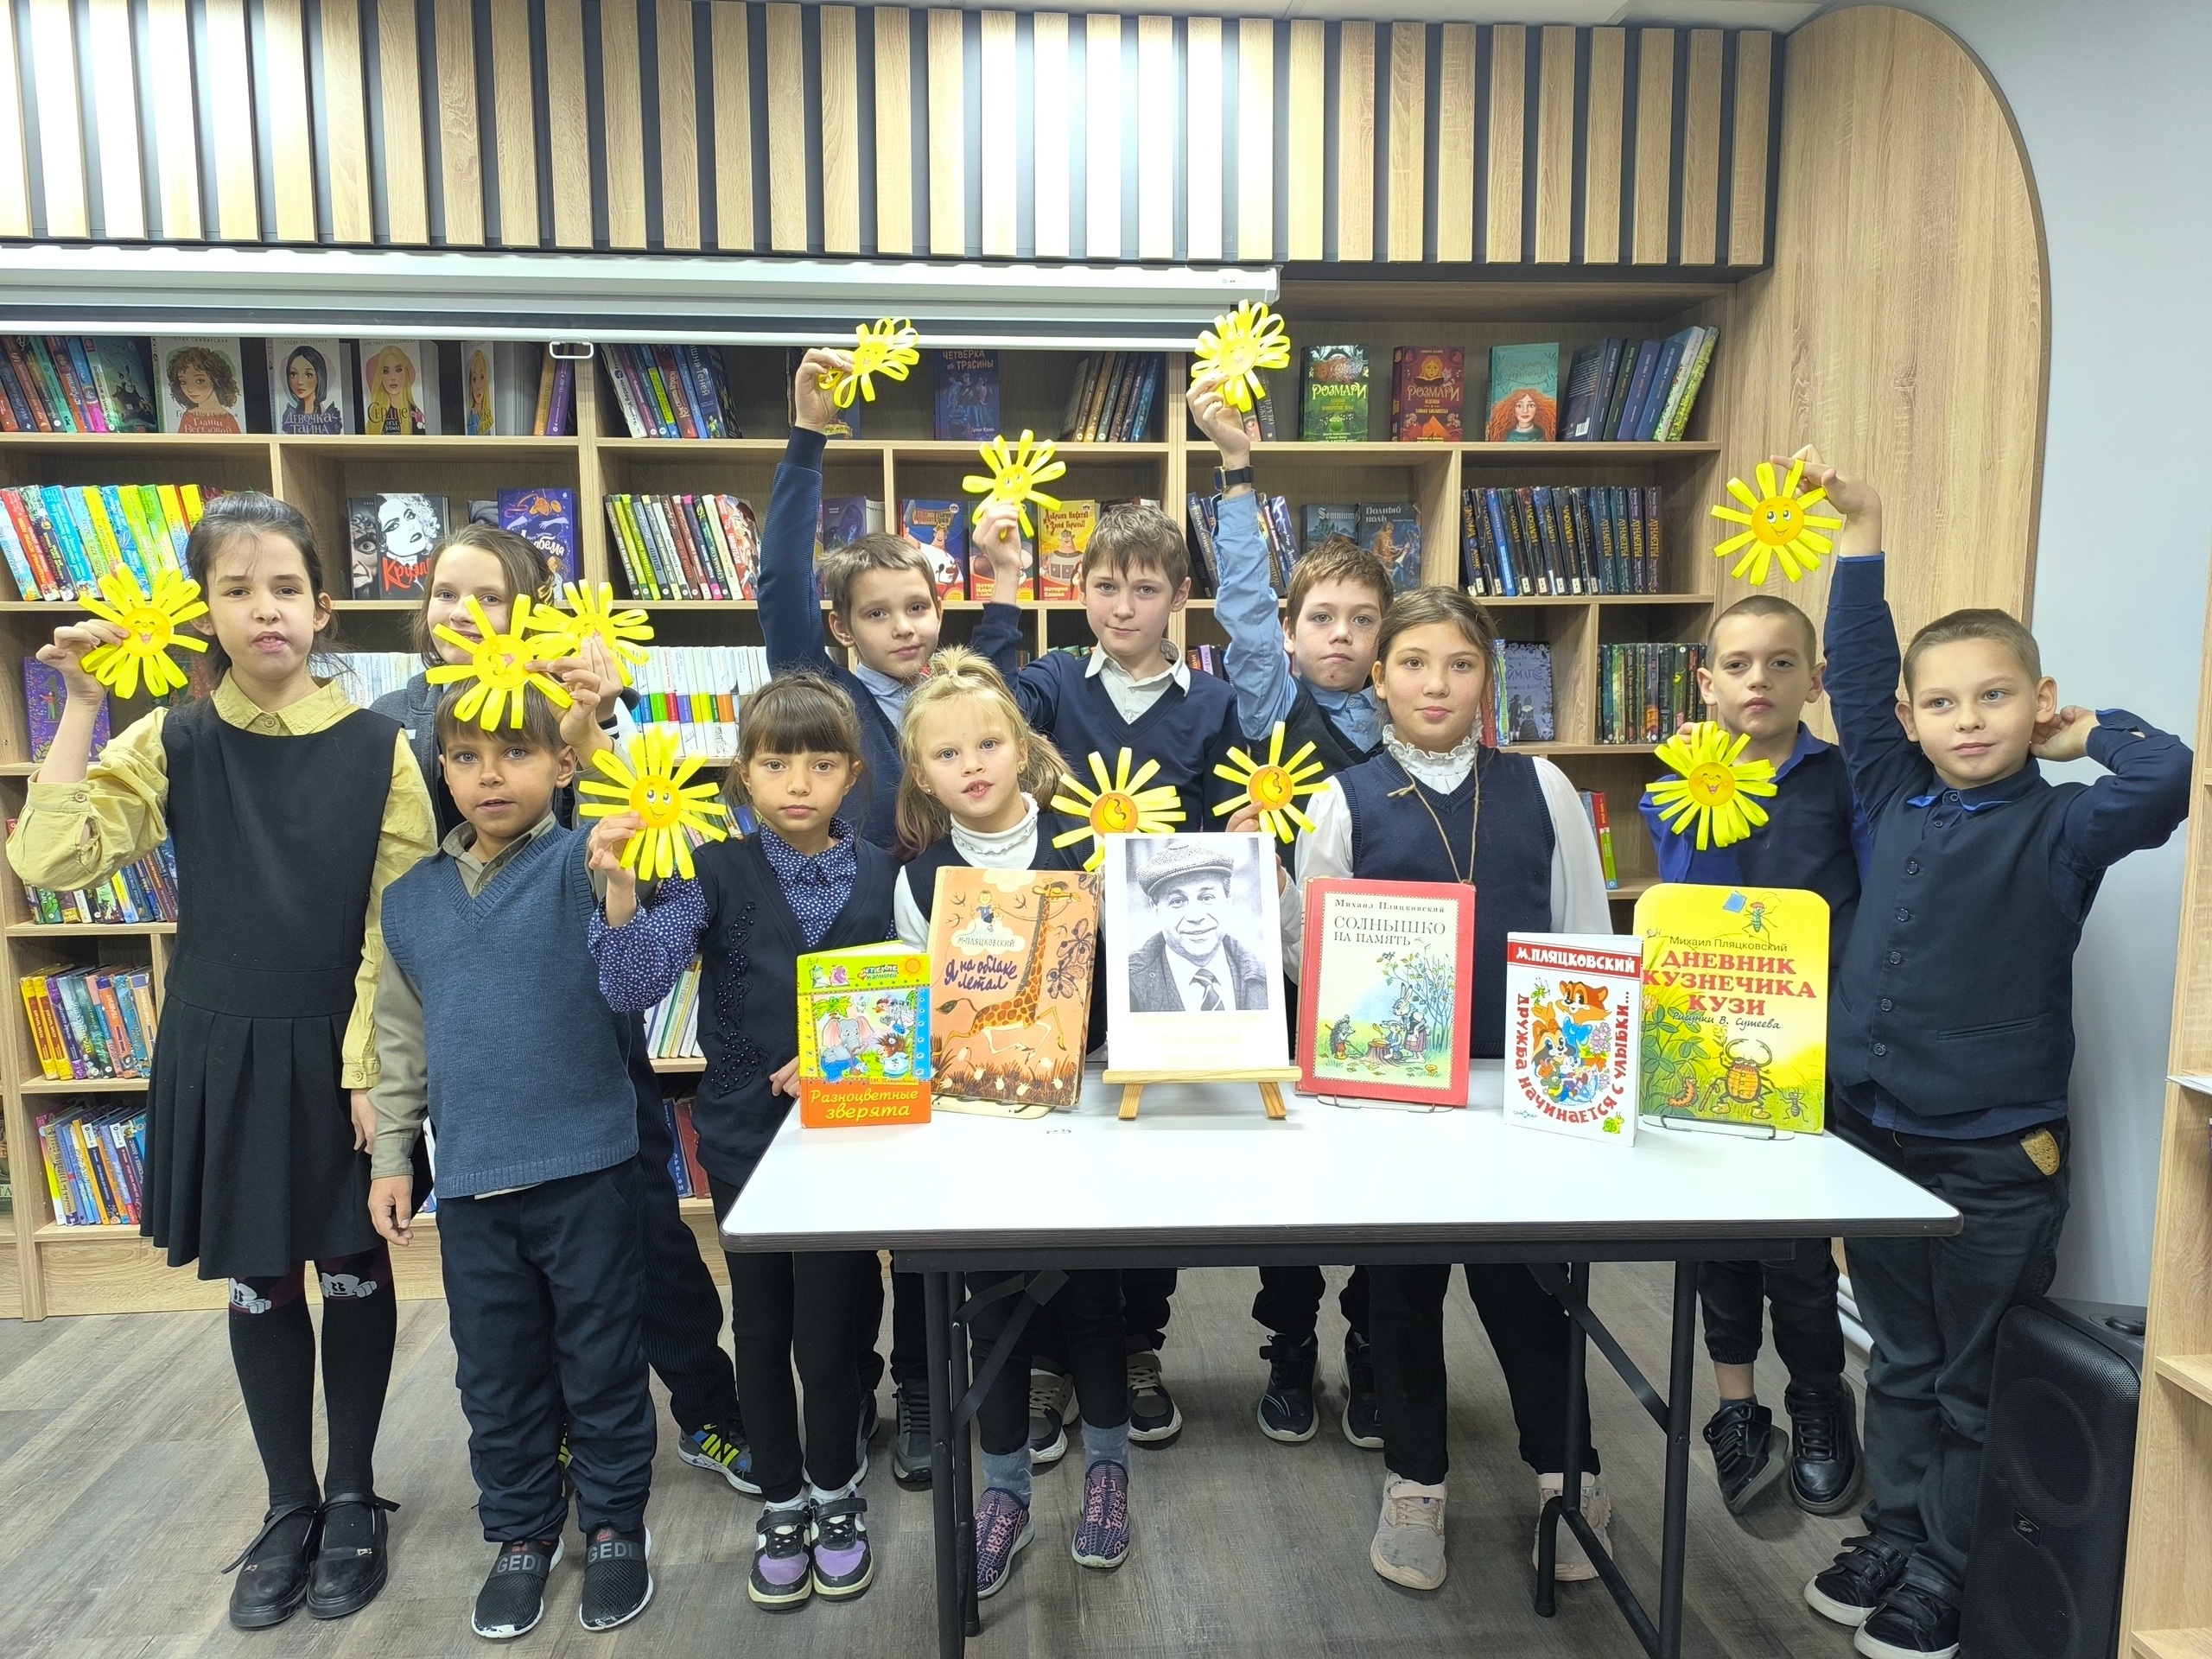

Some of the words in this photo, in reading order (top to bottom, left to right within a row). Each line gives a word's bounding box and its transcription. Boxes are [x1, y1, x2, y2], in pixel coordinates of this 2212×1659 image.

[943, 349, 985, 359] ЧЕТВЕРКА
[957, 359, 994, 370] ТРЯСИНЫ
[1312, 383, 1368, 399] РОЗМАРИ
[1407, 385, 1460, 401] РОЗМАРИ
[1318, 507, 1355, 519] Somnium
[1366, 506, 1402, 515] Полный
[1599, 518, 1612, 557] ЛУНАСТРЫ
[1617, 518, 1630, 557] ЛУНАСТРЫ
[1630, 518, 1643, 558] ЛУНАСТРЫ
[1647, 518, 1661, 557] ЛУНАСТРЫ
[1335, 899, 1374, 909] Михаил
[1379, 901, 1445, 913] Пляцковский
[1334, 915, 1446, 935] СОЛНЫШКО
[1334, 931, 1351, 942] НА
[1356, 933, 1411, 946] ПАМЯТЬ
[1669, 936, 1712, 947] Михаил
[1714, 938, 1788, 952] Пляцковский
[944, 959, 958, 985] Я
[960, 959, 976, 971] на
[977, 955, 1017, 979] облаке
[1661, 950, 1796, 975] ДНЕВНИК
[957, 974, 1007, 991] летал
[1642, 969, 1816, 998] КУЗНЕЧИКА
[106, 993, 118, 1020] ТЕЛЕПАТ
[1688, 995, 1765, 1015] КУЗИ
[1672, 1012, 1714, 1027] Рисунки
[1719, 1015, 1729, 1025] В.
[1735, 1017, 1780, 1030] Сутеева
[810, 1089, 918, 1107] Разноцветные
[825, 1102, 910, 1122] зверята
[588, 1542, 633, 1563] GEDI
[496, 1555, 542, 1573] GEDI
